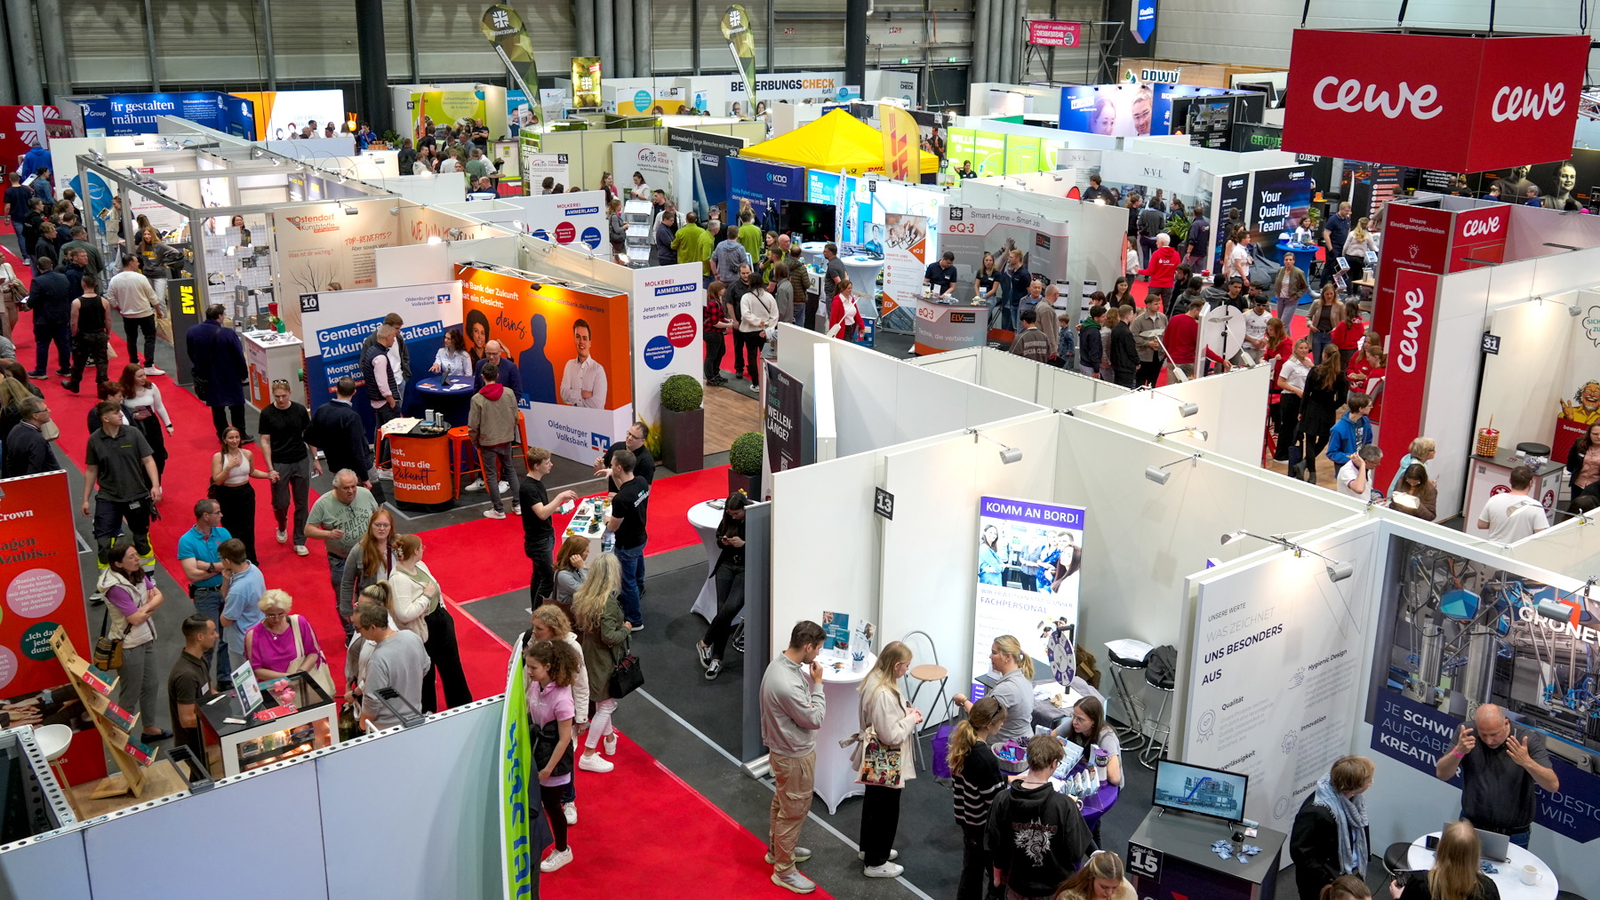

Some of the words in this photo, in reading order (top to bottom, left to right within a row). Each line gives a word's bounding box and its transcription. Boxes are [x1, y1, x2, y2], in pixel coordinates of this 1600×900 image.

[1313, 76, 1443, 120] cewe
[1492, 82, 1566, 122] cewe
[126, 100, 174, 114] gestalten
[773, 174, 787, 183] KDO
[1261, 191, 1282, 203] Your
[294, 213, 334, 223] Ostendorf
[566, 207, 598, 215] AMMERLAND
[1259, 204, 1290, 219] Quality
[949, 223, 974, 233] eQ-3
[1016, 216, 1032, 225] Smart
[1258, 218, 1284, 232] Team!
[1390, 221, 1445, 234] Einstiegsmöglichkeiten
[1463, 216, 1500, 237] cewe
[411, 220, 423, 240] WE
[344, 232, 392, 246] TOP-BENEFITS?
[314, 249, 333, 257] wichtig?
[644, 279, 674, 287] MOLKEREI
[656, 284, 695, 296] AMMERLAND
[470, 283, 484, 292] Bank
[495, 288, 519, 300] Zukunft
[182, 285, 195, 315] EWE
[302, 297, 317, 308] 10
[480, 297, 504, 309] Gesicht:
[643, 312, 670, 321] bewerben:
[919, 308, 934, 319] eQ-3
[319, 322, 384, 342] Gemeinsa
[496, 311, 527, 339] deins.
[1397, 288, 1424, 373] cewe
[1483, 340, 1498, 350] 31
[327, 363, 359, 375] Morgen
[769, 384, 778, 394] AUF
[768, 394, 780, 407] EINER
[768, 404, 793, 430] WELLEN-
[548, 419, 588, 437] Oldenburger
[767, 418, 790, 442] LÄNGE?
[556, 432, 588, 448] Volksbank
[417, 460, 431, 468] die
[392, 467, 437, 486] Zukunft
[877, 496, 892, 513] 13
[986, 502, 1023, 516] KOMM
[1024, 508, 1041, 518] AN
[1044, 512, 1079, 524] BORD!
[36, 573, 55, 581] Crown
[18, 582, 34, 590] Foods
[981, 597, 1047, 614] FACHPERSONAL
[1208, 609, 1227, 622] UNSERE
[1228, 602, 1246, 615] WERTE
[1207, 628, 1228, 643] WAS
[1230, 607, 1275, 634] ZEICHNET
[1204, 648, 1225, 664] UNS
[1227, 624, 1283, 655] BESONDERS
[1308, 656, 1329, 671] Hygienic
[1330, 650, 1348, 661] Design
[1202, 669, 1222, 686] AUS
[1222, 696, 1244, 711] Qualität
[1384, 700, 1400, 717] JE
[1300, 715, 1326, 732] Innovation
[1541, 802, 1576, 829] WIR.
[1131, 852, 1158, 873] 15
